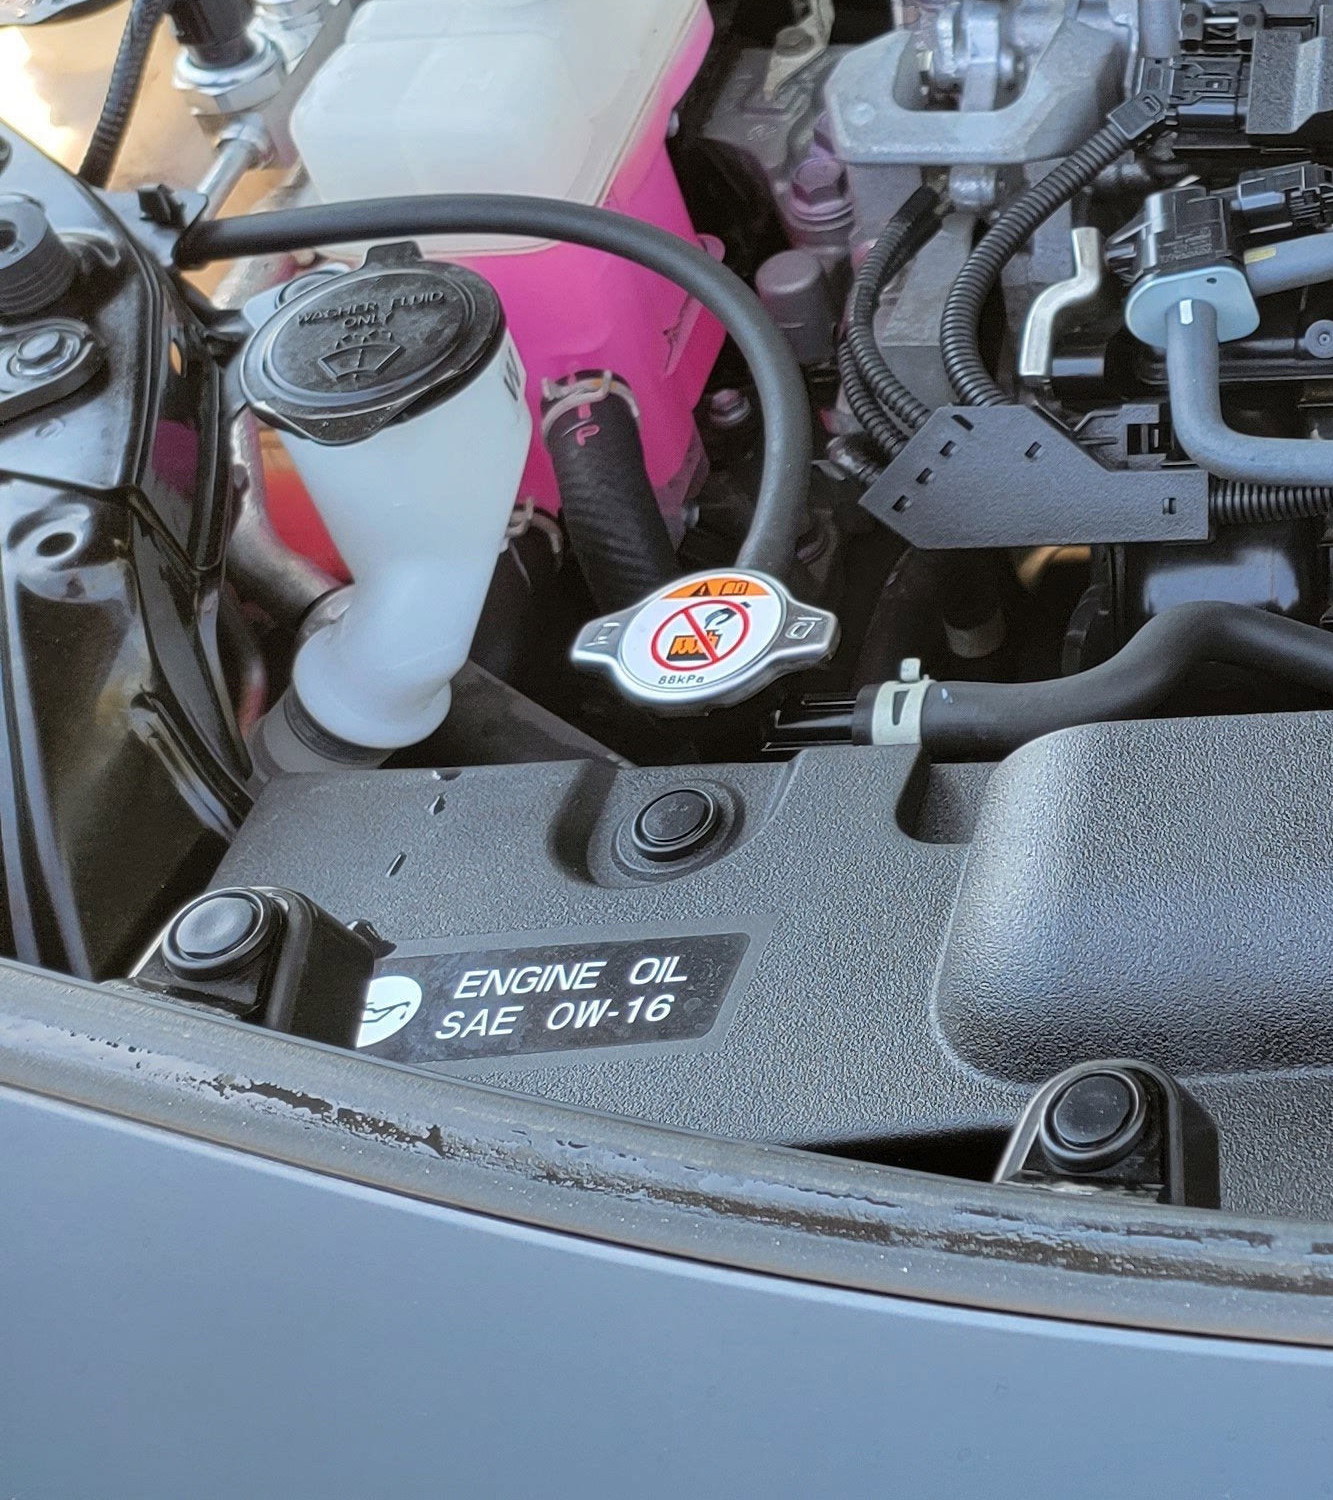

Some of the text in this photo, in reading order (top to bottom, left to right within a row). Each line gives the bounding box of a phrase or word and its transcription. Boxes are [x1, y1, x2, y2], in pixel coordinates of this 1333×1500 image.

[391, 291, 444, 311] FLUID
[343, 311, 393, 328] ONLY
[658, 674, 705, 685] 88kPa
[454, 956, 688, 999] ENGINE OIL
[435, 994, 676, 1040] SAE 0W-16
